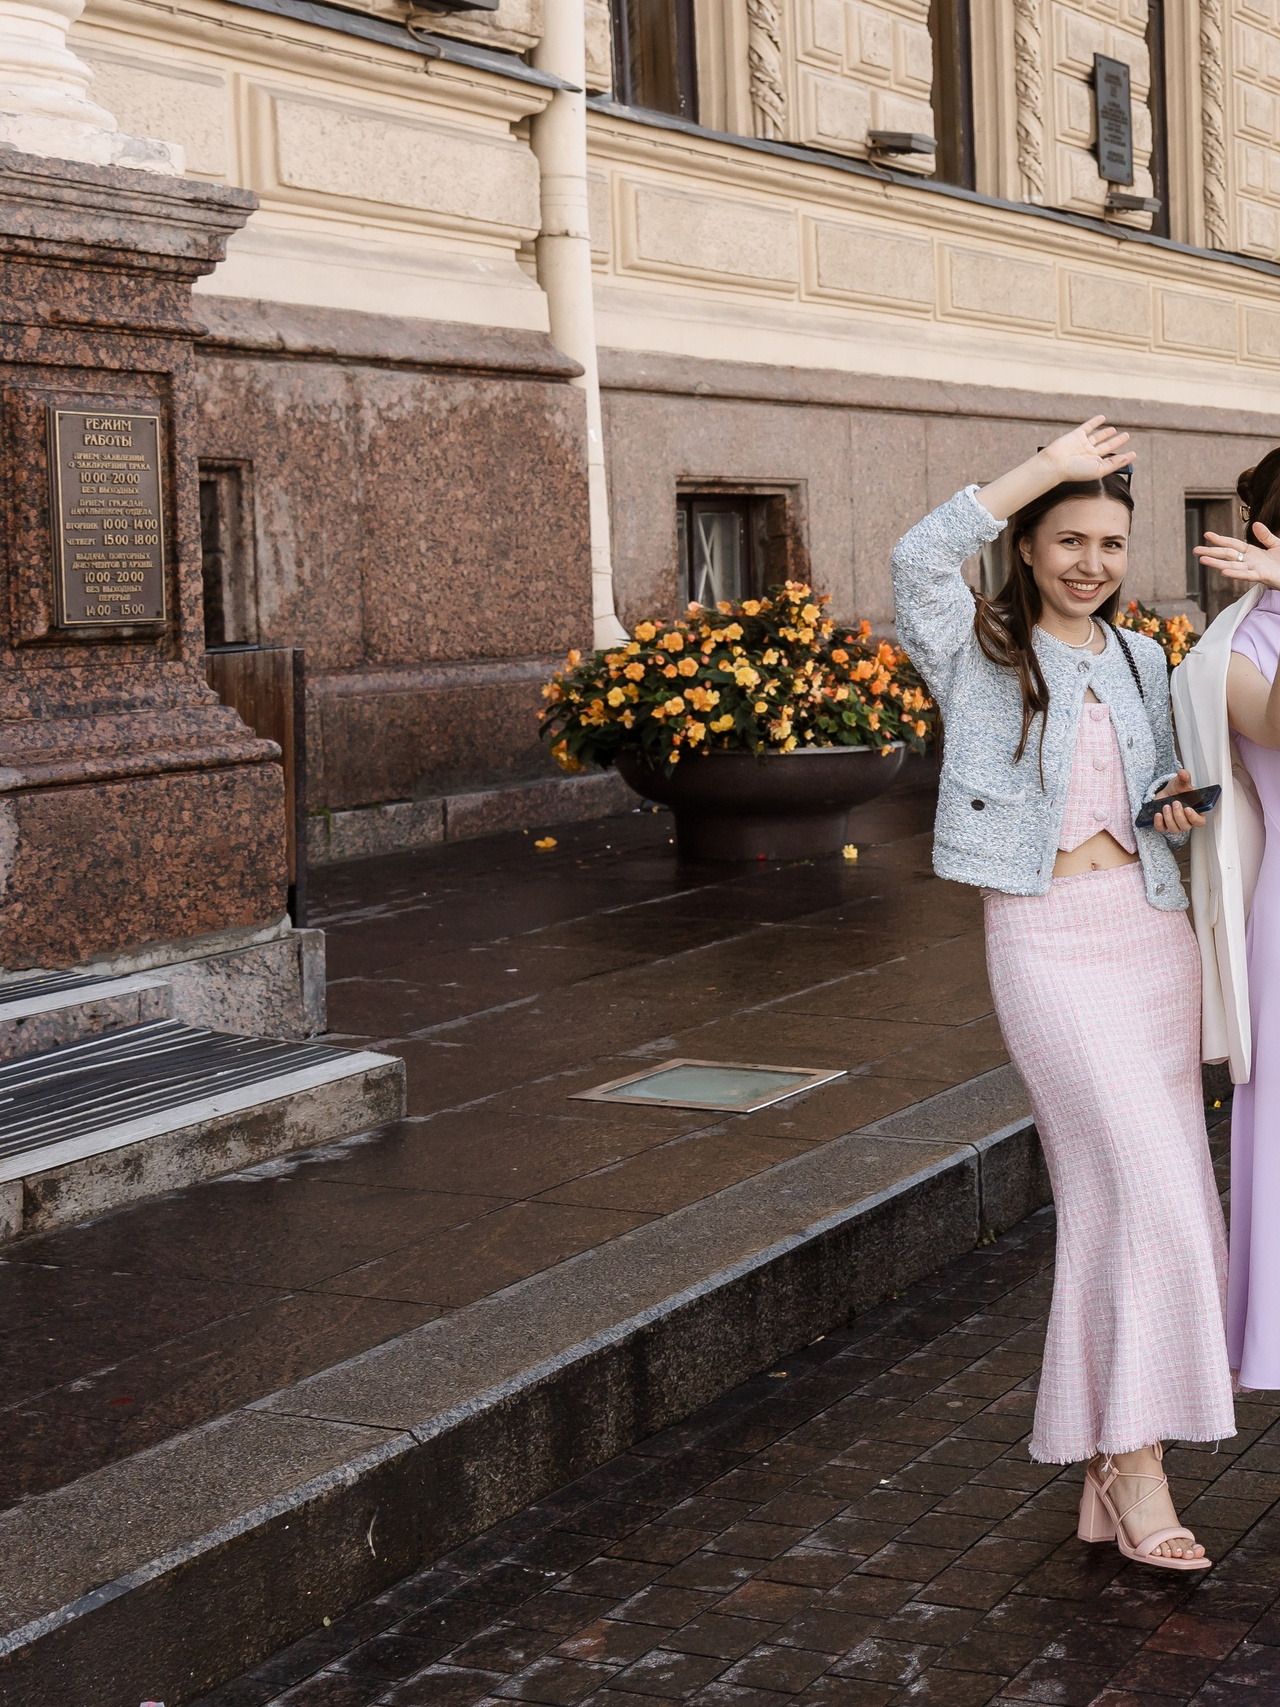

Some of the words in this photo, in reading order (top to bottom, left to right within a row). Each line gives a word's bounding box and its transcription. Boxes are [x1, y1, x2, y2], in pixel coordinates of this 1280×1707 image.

[85, 418, 132, 431] РЕЖИМ
[84, 434, 132, 447] РАБОТЫ
[66, 522, 99, 530] ВТОРНИК
[66, 538, 96, 546] ЧЕТВЕРГ
[102, 585, 142, 593] ВЫХОДНЫХ
[98, 594, 131, 602] ПЕРЕРЫВ
